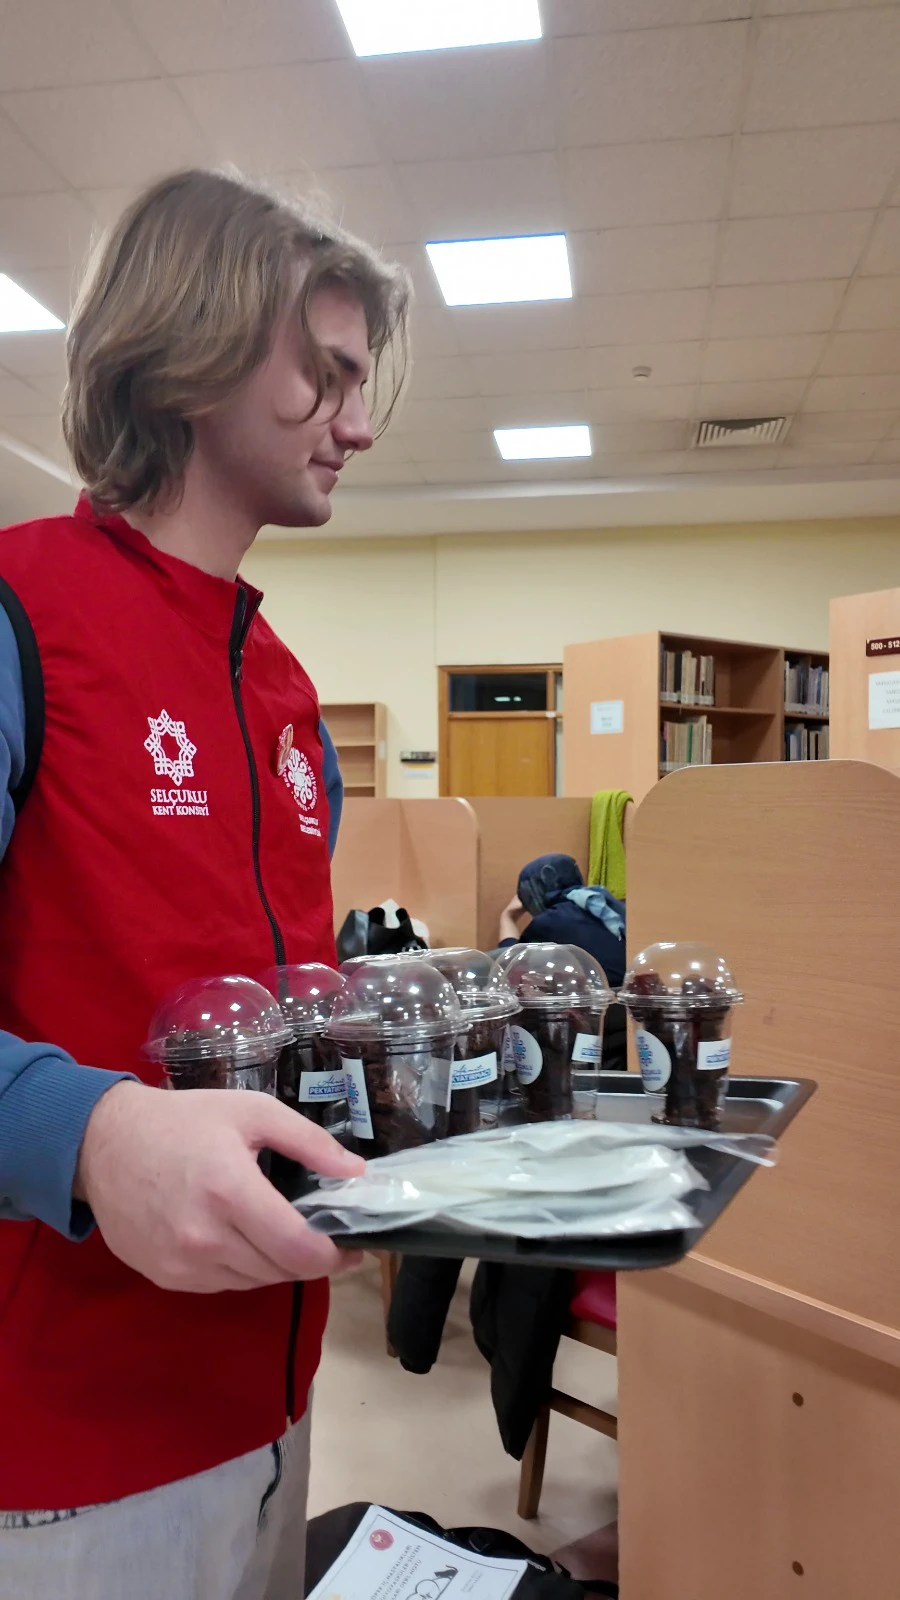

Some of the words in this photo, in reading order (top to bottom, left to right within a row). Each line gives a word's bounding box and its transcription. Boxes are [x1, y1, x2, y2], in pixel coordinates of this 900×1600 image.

[870, 642, 883, 650] 500
[150, 788, 208, 806] SELÇUKLU
[152, 805, 174, 816] KENT
[175, 804, 210, 816] KONSEYİ
